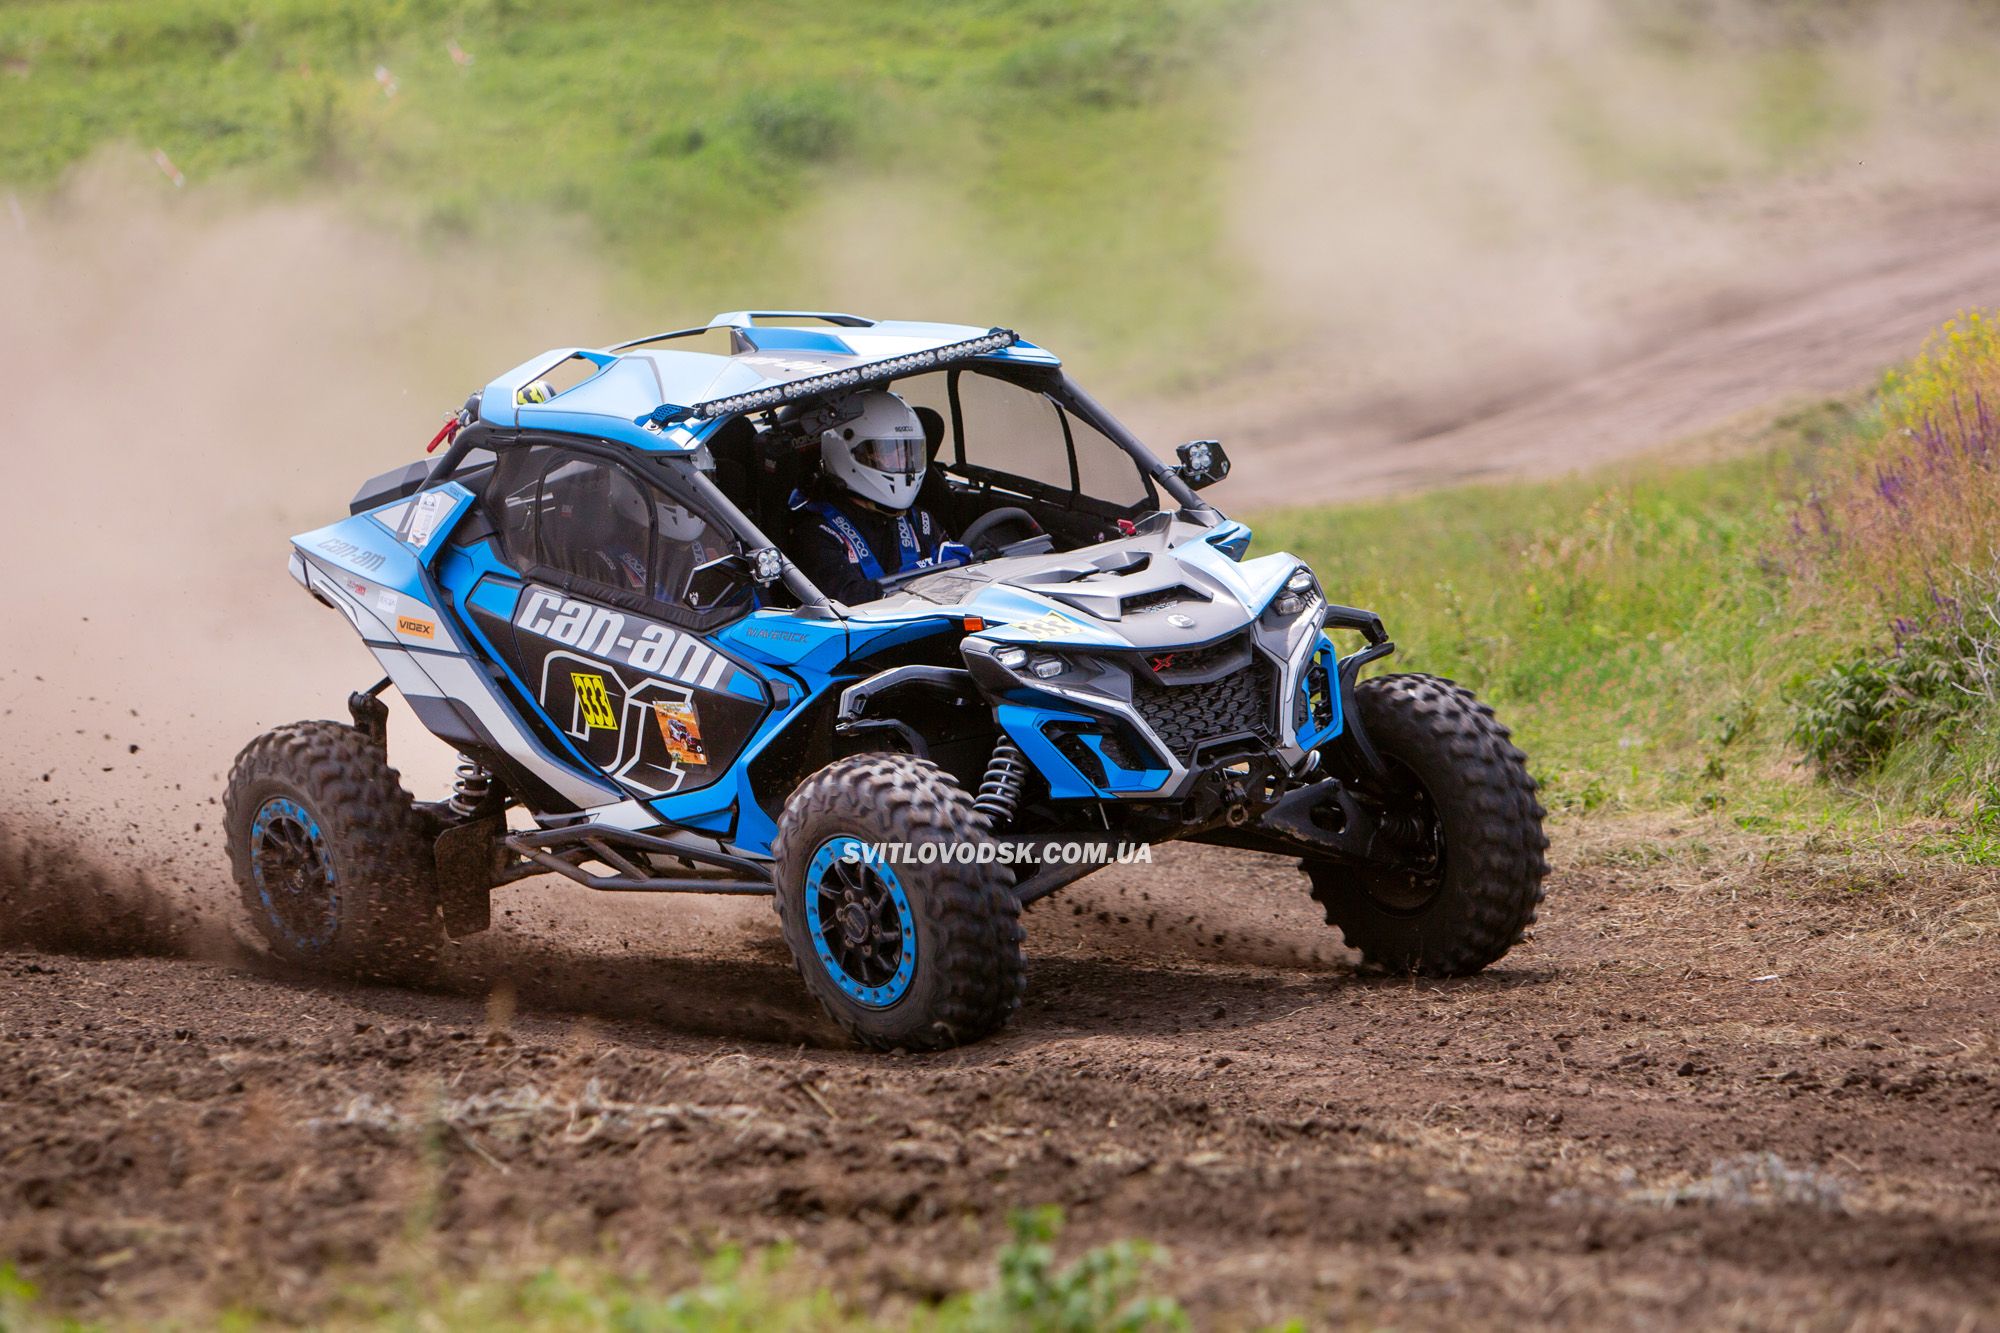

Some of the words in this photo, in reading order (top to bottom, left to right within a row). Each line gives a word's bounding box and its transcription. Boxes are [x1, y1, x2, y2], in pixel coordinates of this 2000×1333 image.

[400, 619, 430, 634] VIDEX
[516, 591, 729, 690] can-am
[746, 627, 809, 642] MAVERICK
[574, 675, 613, 727] 333
